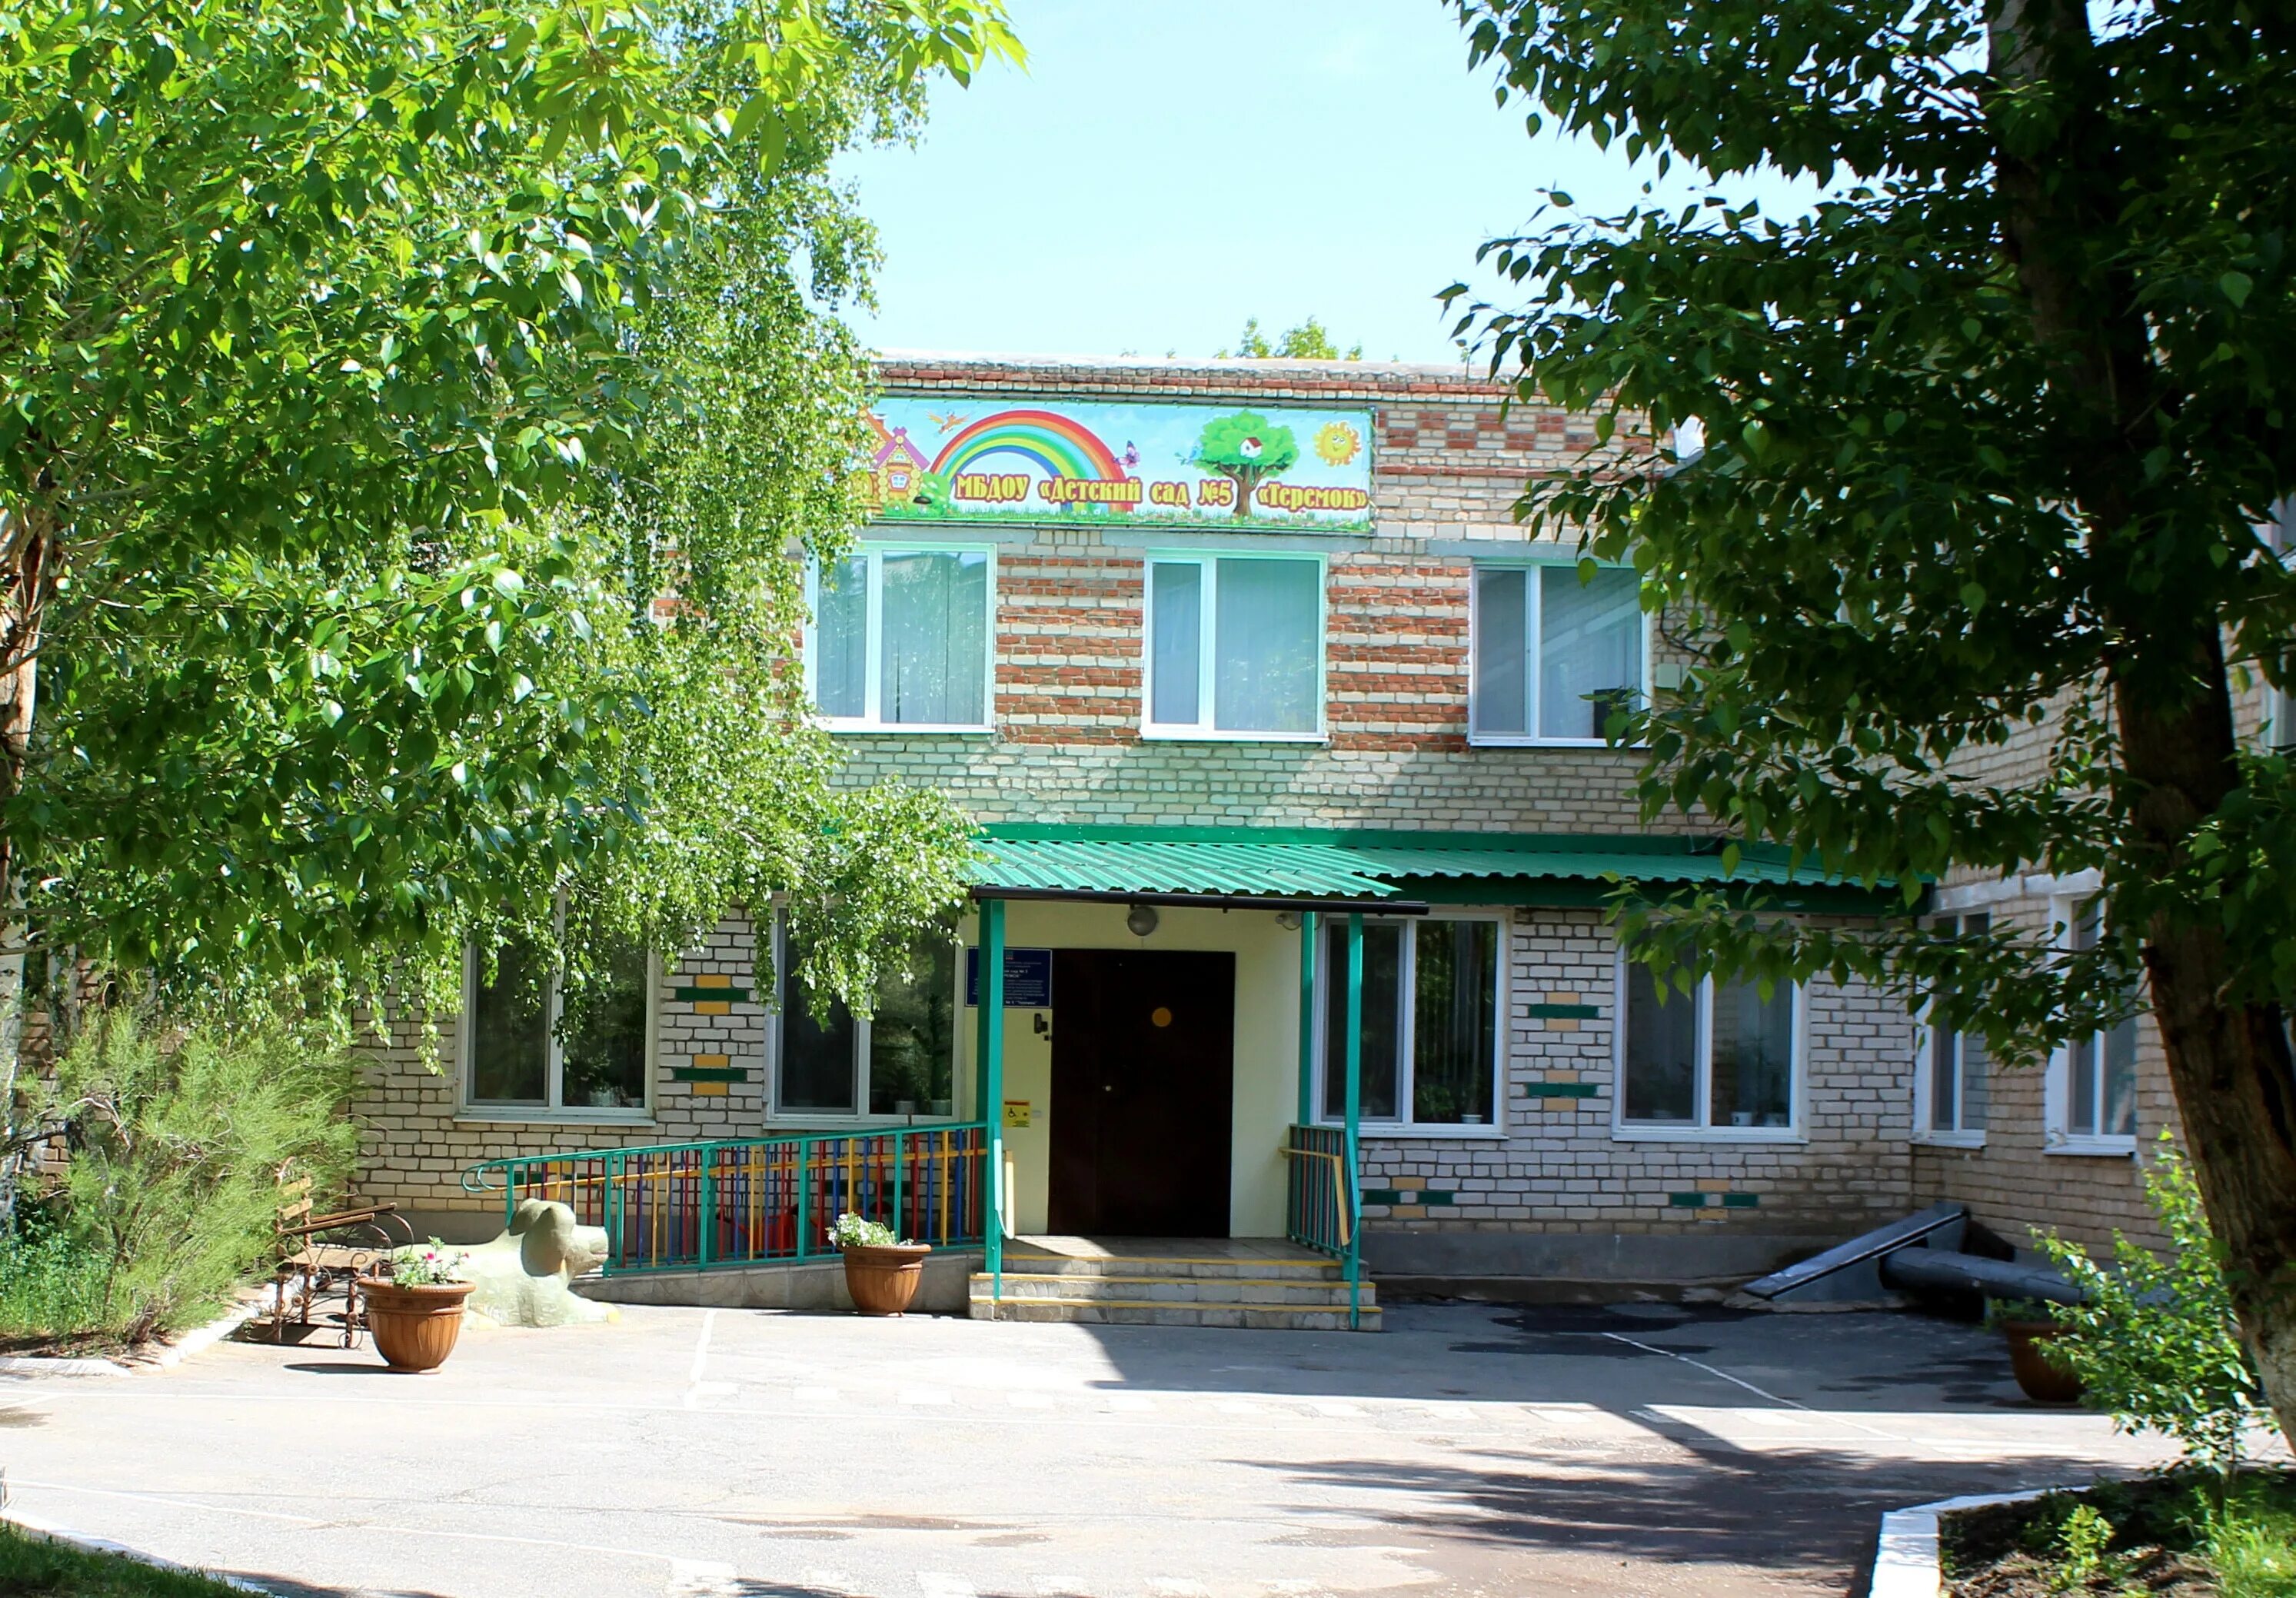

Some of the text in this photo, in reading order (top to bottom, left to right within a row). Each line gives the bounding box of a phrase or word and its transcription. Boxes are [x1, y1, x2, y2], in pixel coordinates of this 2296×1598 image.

[956, 474, 1369, 511] МБДОУ «Детский сад №5 «Теремок»
